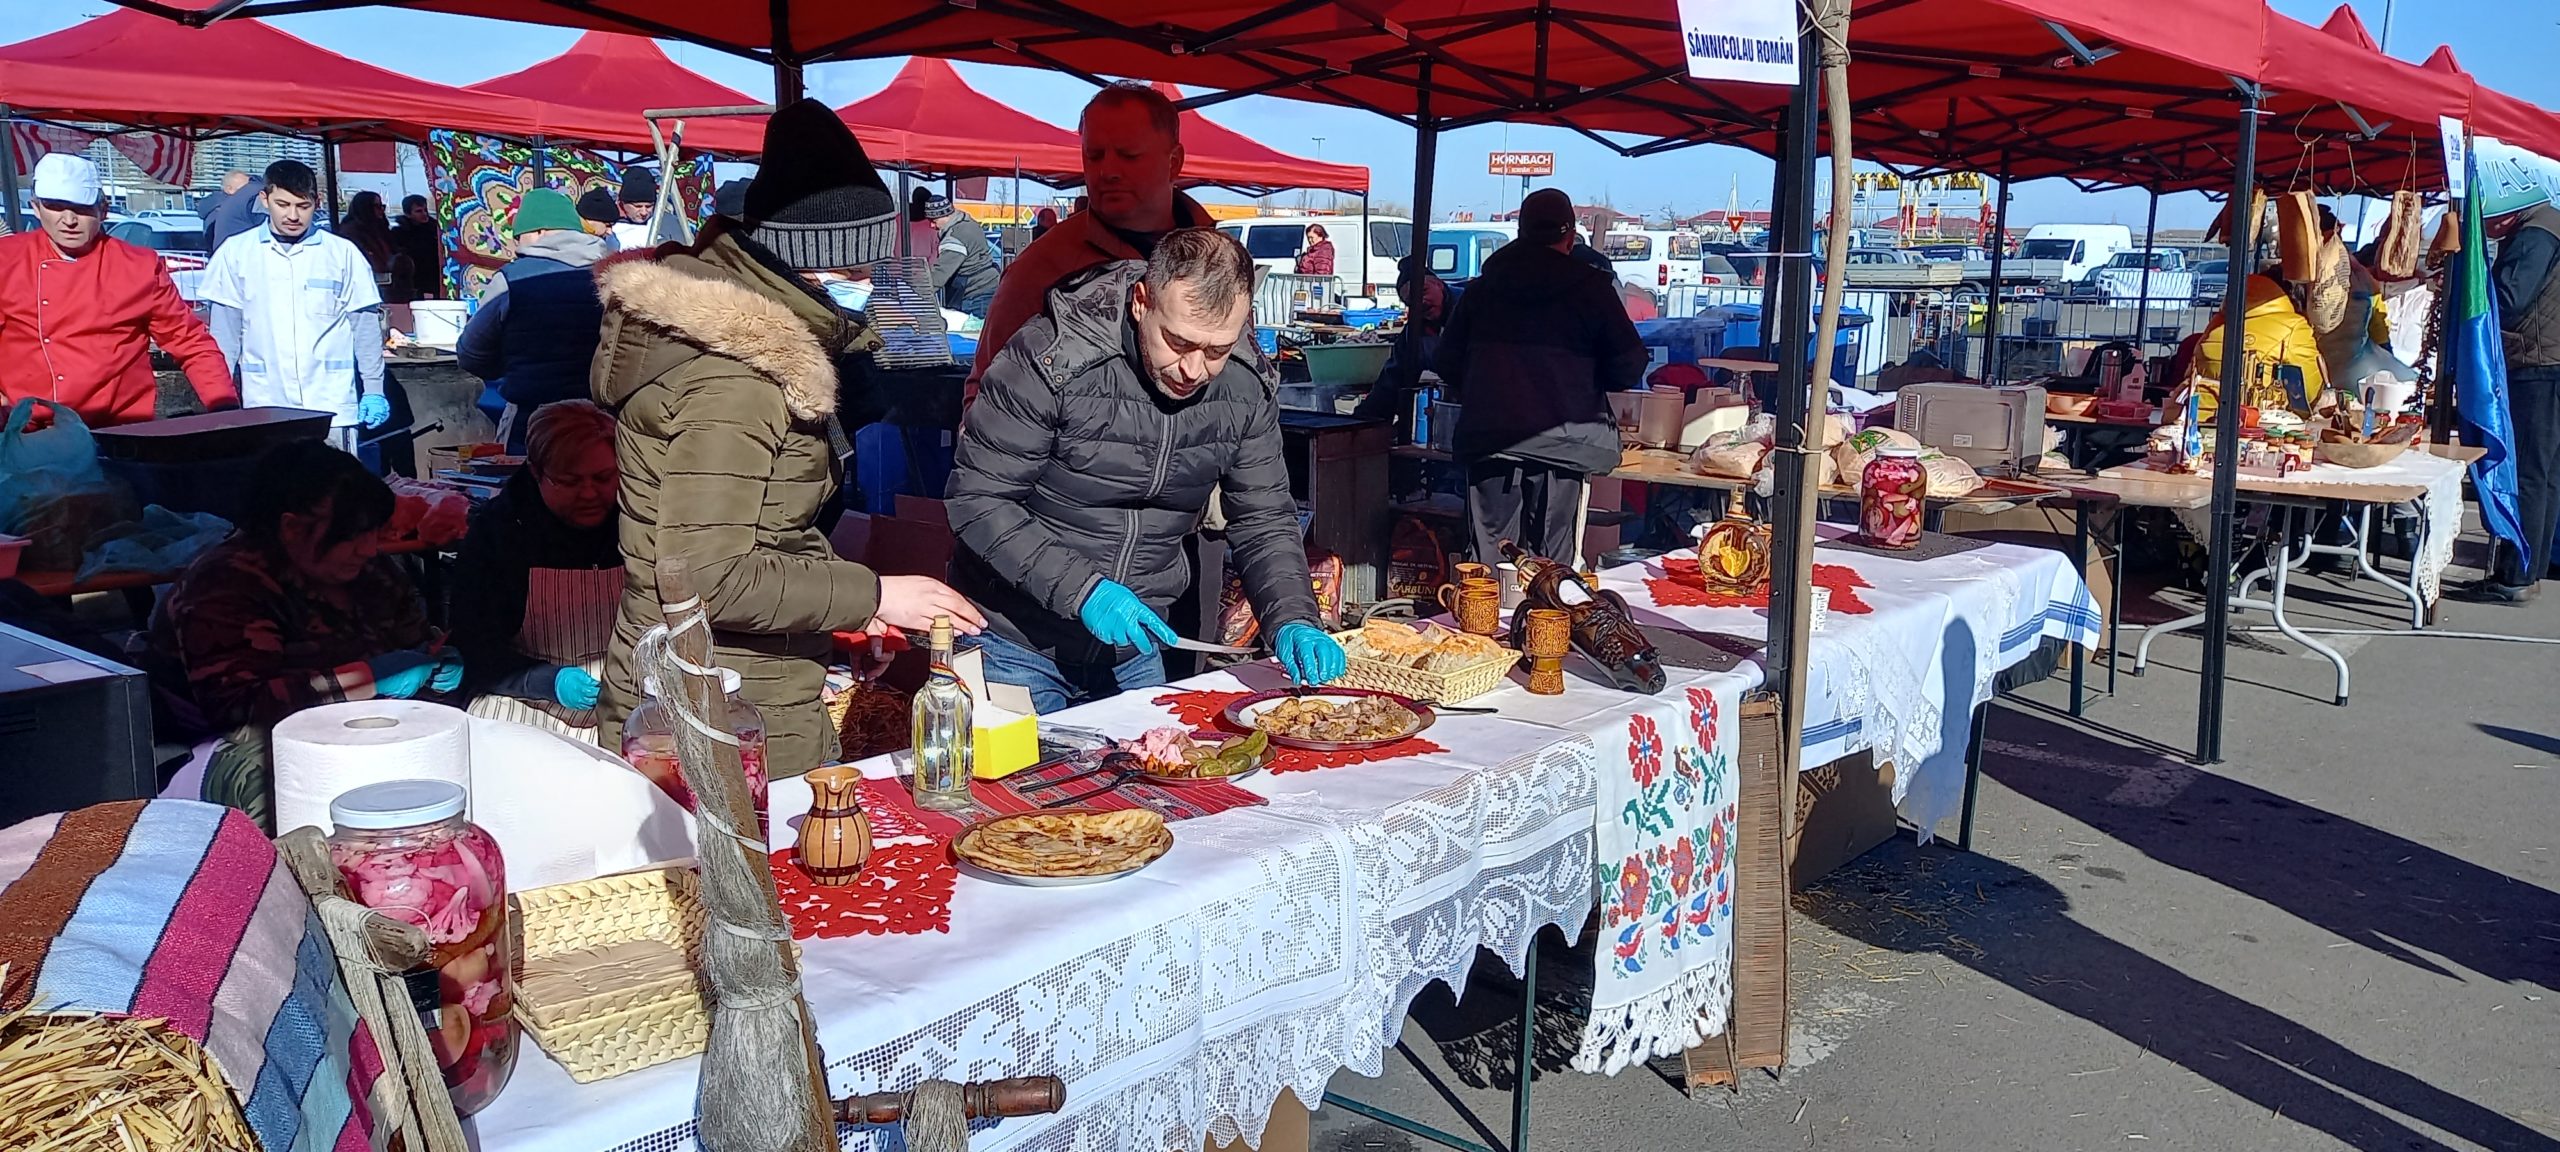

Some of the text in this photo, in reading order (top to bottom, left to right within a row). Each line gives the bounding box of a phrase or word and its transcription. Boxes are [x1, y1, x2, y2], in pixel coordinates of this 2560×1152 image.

[1687, 27, 1794, 65] SÂNNICOLAU ROMÂN
[1491, 154, 1551, 165] HORNBACH
